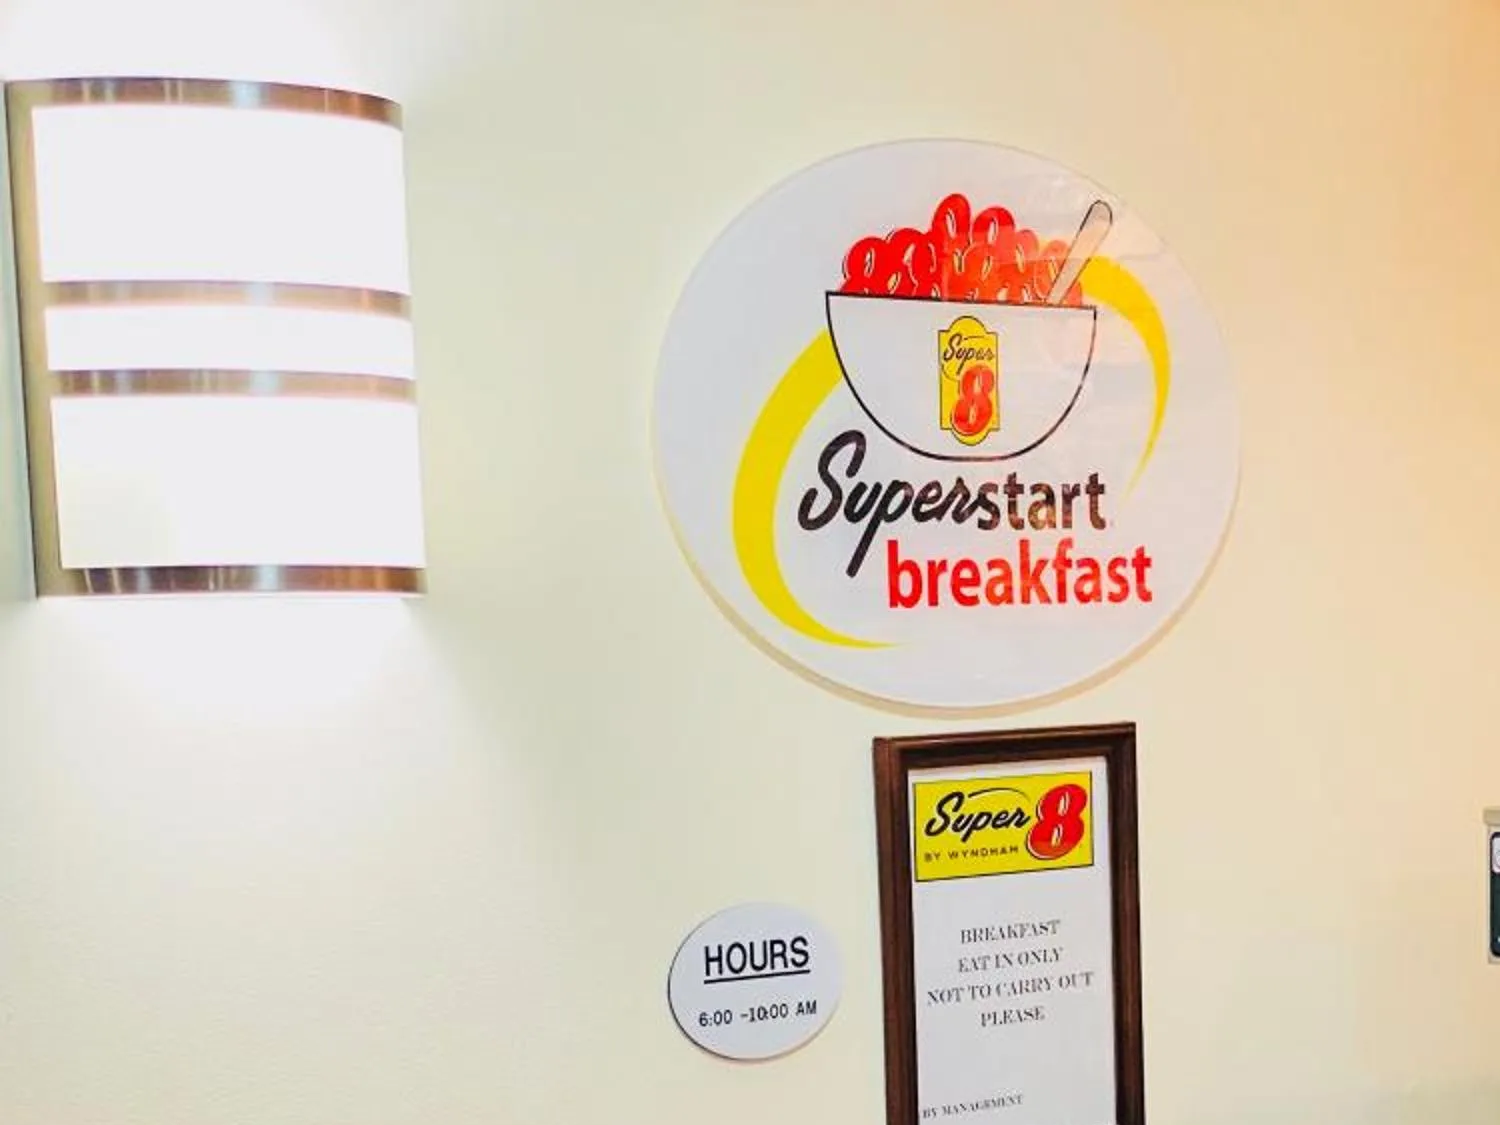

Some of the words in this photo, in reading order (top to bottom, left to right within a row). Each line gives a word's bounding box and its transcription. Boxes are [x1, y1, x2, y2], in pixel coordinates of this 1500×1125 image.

[943, 332, 995, 376] Super
[950, 364, 995, 437] 8
[798, 430, 1107, 577] Superstart
[887, 538, 1153, 609] breakfast
[924, 788, 1031, 843] Super
[1026, 783, 1088, 861] 8
[923, 851, 941, 863] BY
[947, 845, 1019, 860] WYNDHAM
[960, 919, 1062, 945] BREAKFAST
[704, 936, 810, 977] HOURS
[958, 956, 991, 973] EAT
[994, 952, 1014, 969] IN
[1017, 947, 1064, 966] ONLY
[927, 987, 965, 1006] NOT
[966, 983, 991, 1001] TO
[996, 977, 1054, 997] CARRY
[1058, 971, 1094, 990] OUT
[699, 1009, 733, 1028] 6:00
[796, 999, 817, 1016] AM
[980, 1006, 1046, 1028] PLEASE
[923, 1106, 937, 1119] BY
